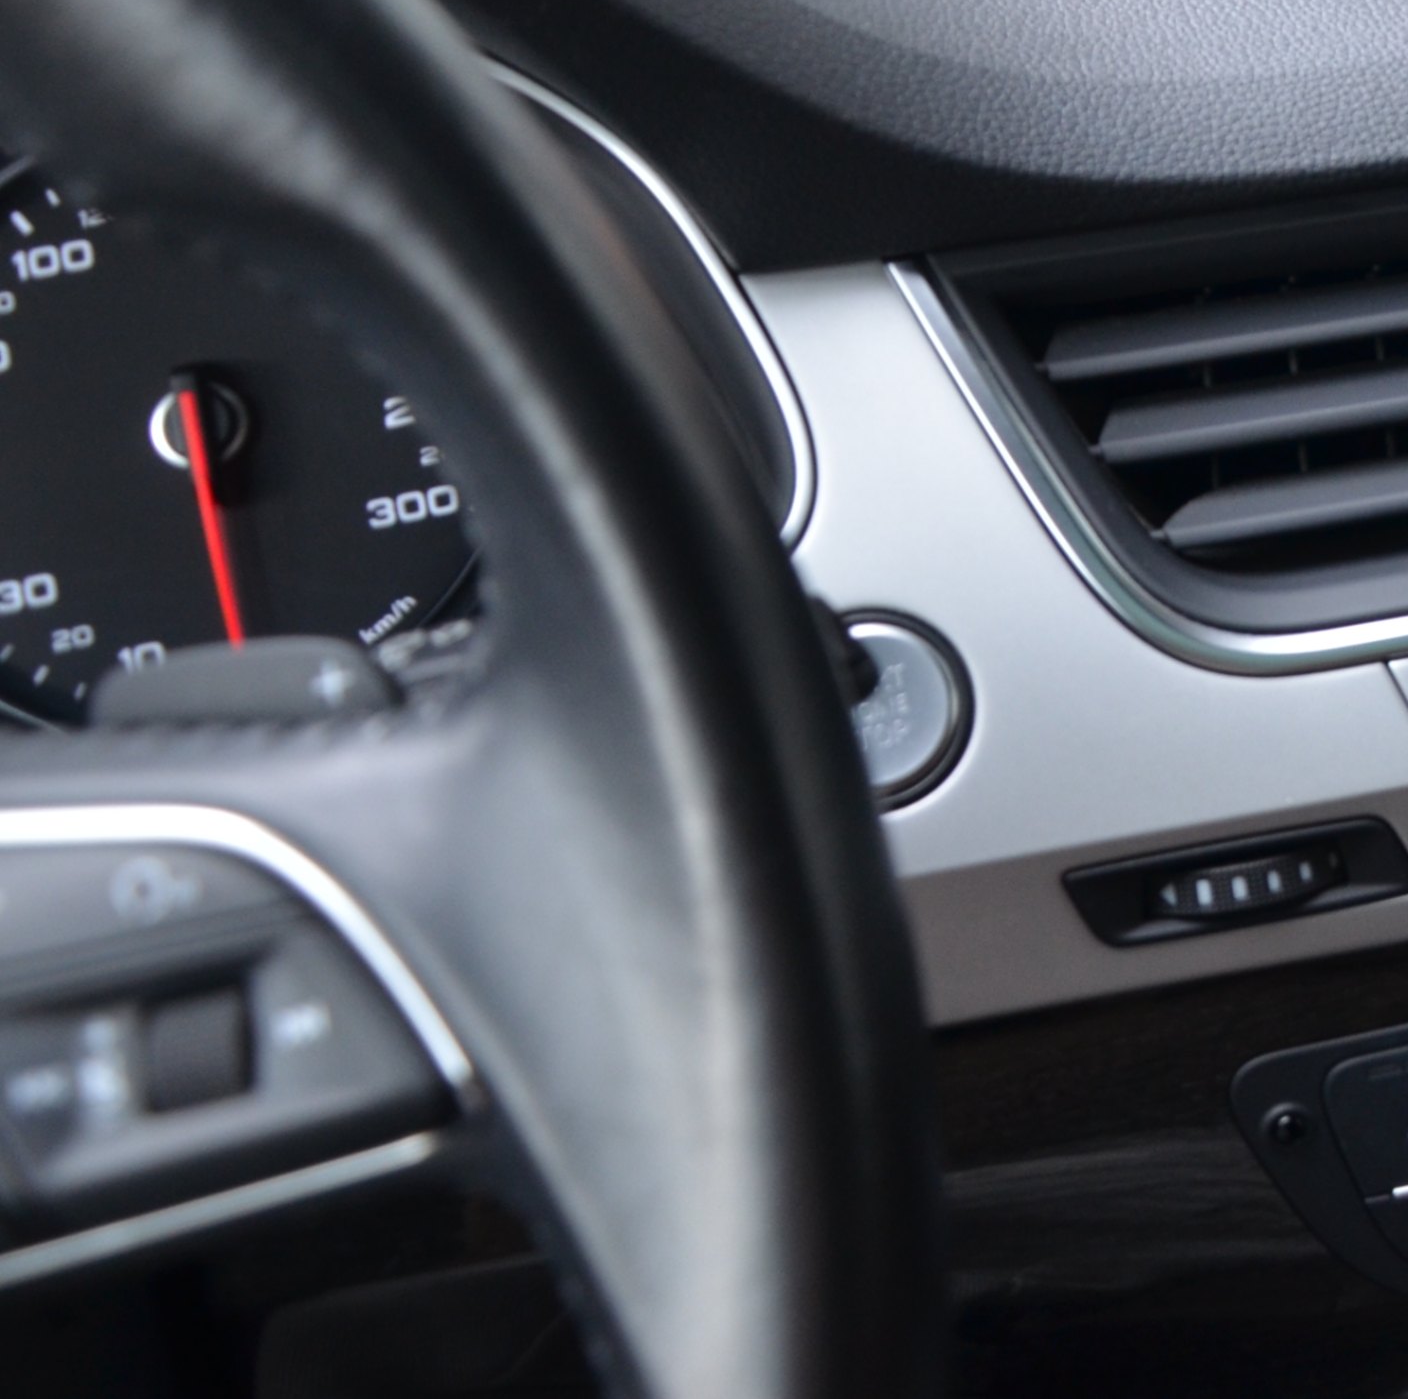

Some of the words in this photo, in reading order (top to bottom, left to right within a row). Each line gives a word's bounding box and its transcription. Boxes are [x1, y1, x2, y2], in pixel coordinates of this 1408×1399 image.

[12, 239, 95, 282] 100
[366, 484, 459, 529] 300
[52, 624, 96, 654] 20
[359, 595, 417, 645] km/h
